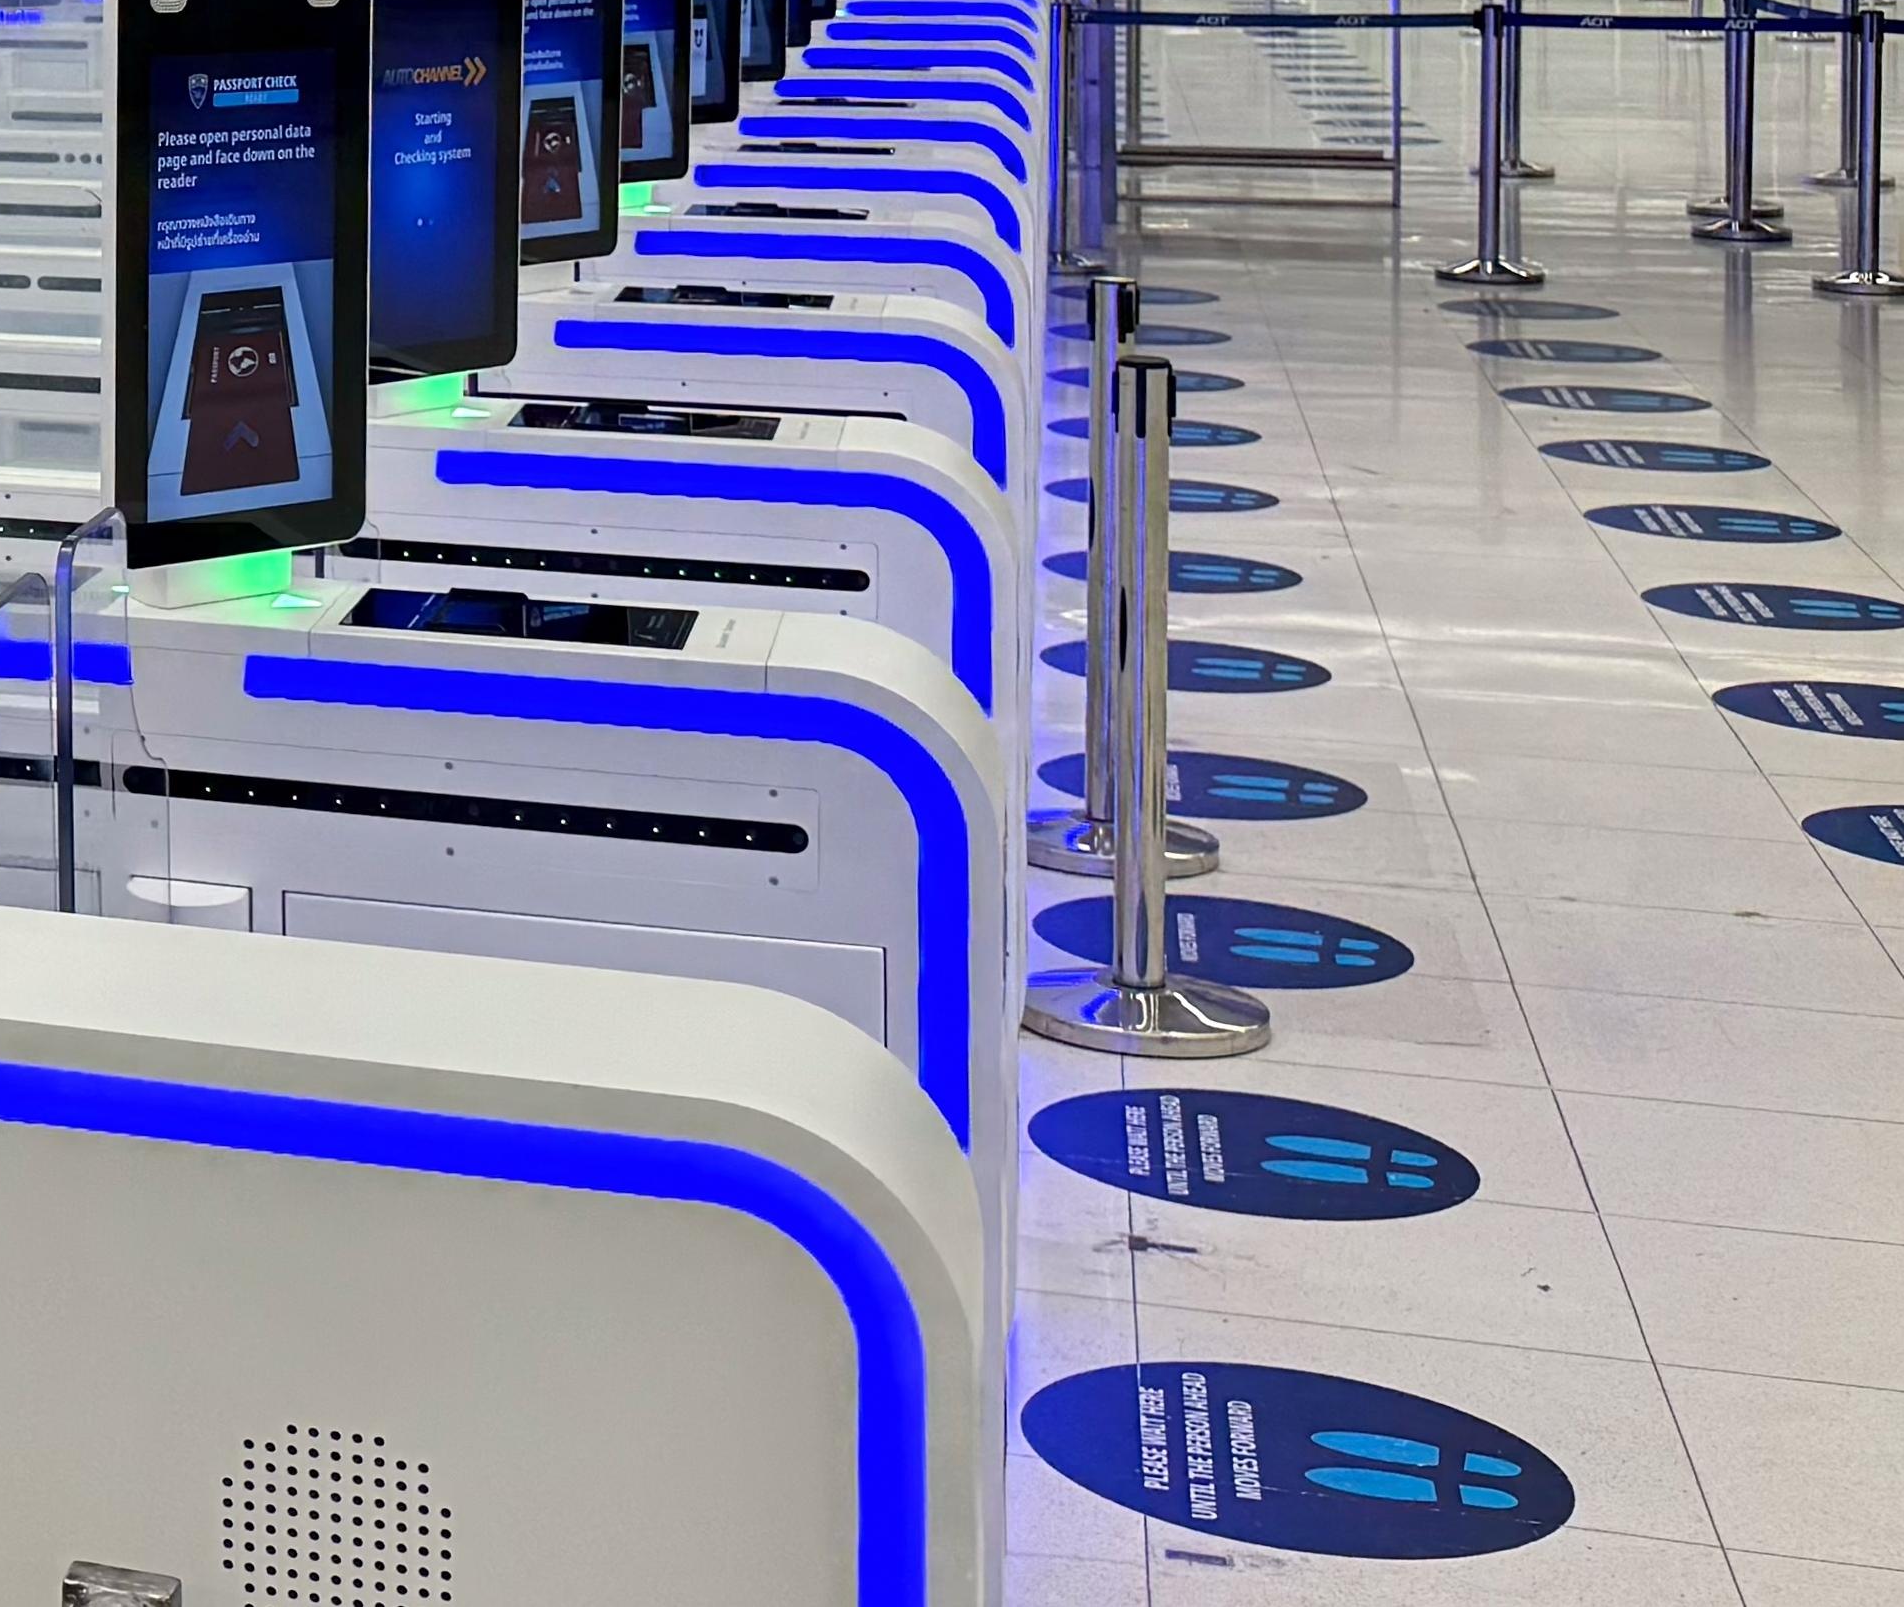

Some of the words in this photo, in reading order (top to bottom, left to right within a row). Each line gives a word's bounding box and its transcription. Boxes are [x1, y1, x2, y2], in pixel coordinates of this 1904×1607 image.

[1580, 16, 1614, 29] AOT
[1724, 18, 1759, 30] AOT
[213, 77, 263, 91] PASSPORT
[265, 75, 297, 89] CHECK
[415, 111, 452, 126] Starting
[158, 131, 197, 147] Please
[199, 131, 229, 147] open
[231, 125, 283, 145] personal
[285, 124, 312, 139] data
[424, 130, 442, 145] and
[157, 155, 188, 172] page
[190, 150, 213, 166] and
[215, 149, 240, 164] face
[243, 148, 275, 162] down
[278, 148, 294, 160] on
[295, 144, 315, 159] the
[394, 149, 437, 165] Checking
[438, 148, 472, 164] system
[157, 173, 198, 190] reader
[1127, 1145, 1150, 1176] PLEASE
[1138, 1386, 1166, 1416] HERE
[1181, 1372, 1209, 1410] AHEAD
[1139, 1415, 1167, 1446] WAIT
[1184, 1409, 1213, 1456] PERSON
[1226, 1400, 1257, 1457] FORWARD
[1141, 1446, 1170, 1491] PLEASE
[1187, 1455, 1214, 1480] THE
[1232, 1456, 1262, 1500] MOVES
[1189, 1483, 1218, 1520] UNTIL
